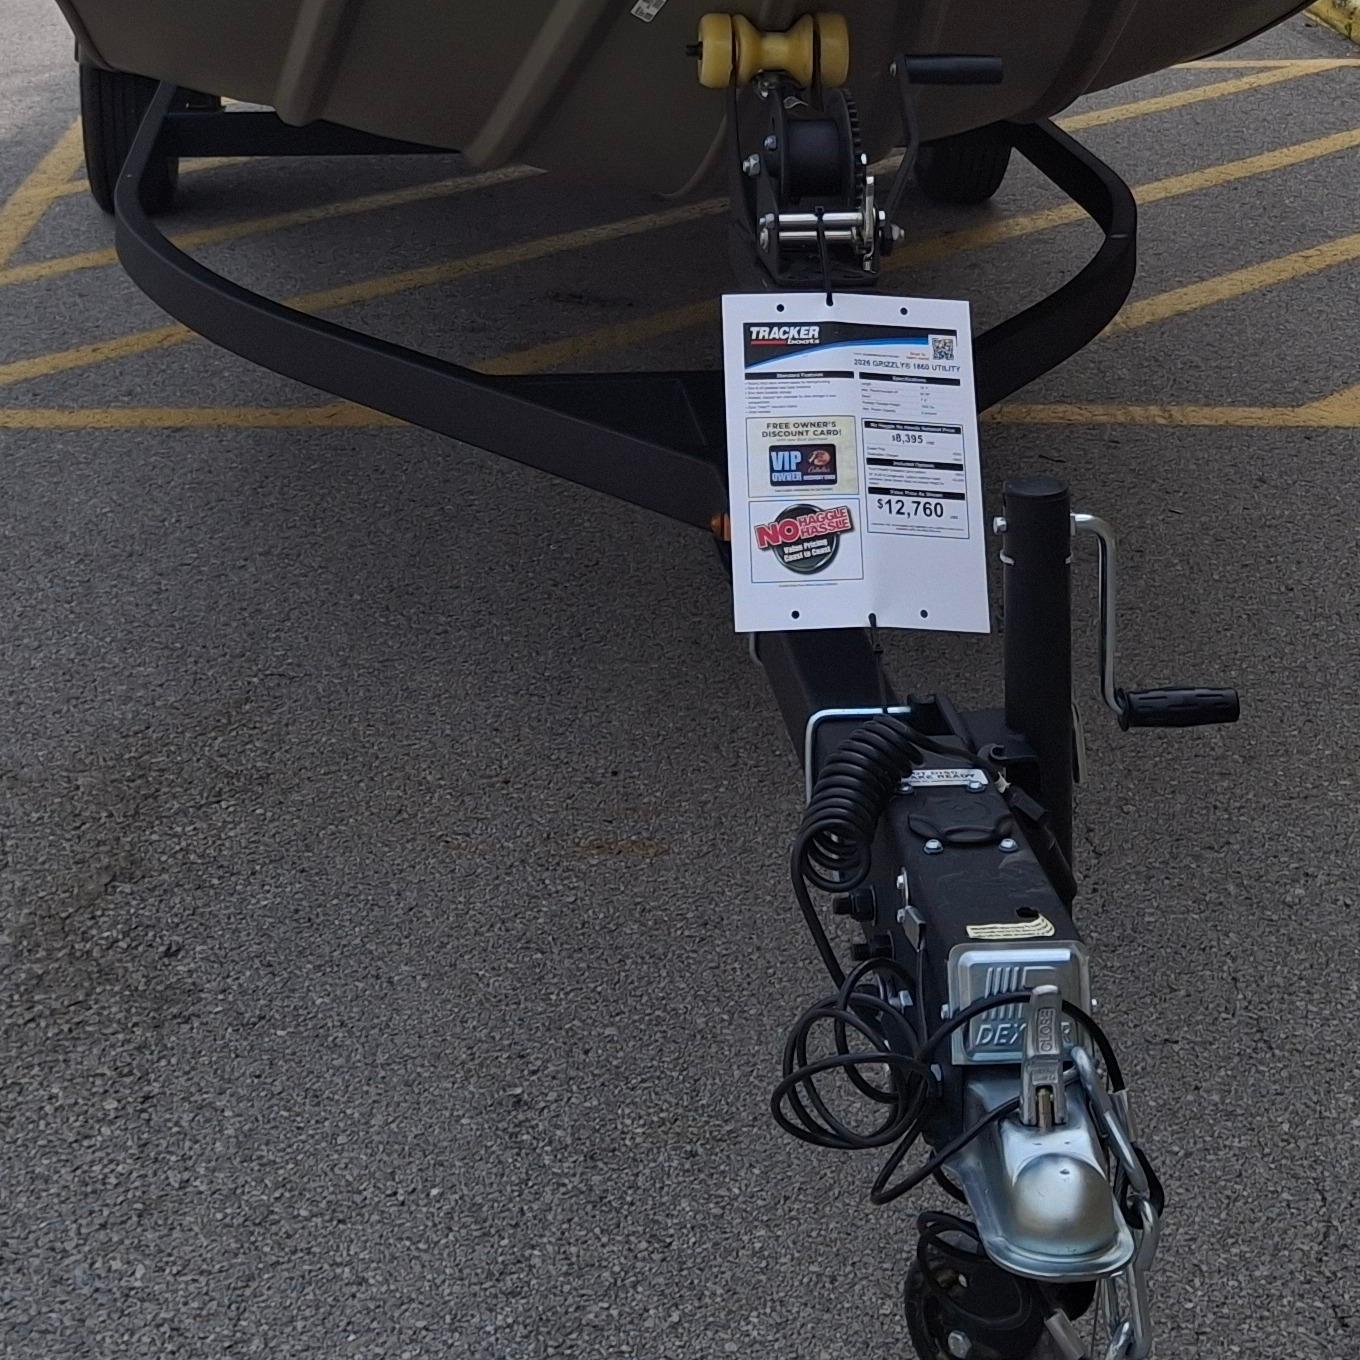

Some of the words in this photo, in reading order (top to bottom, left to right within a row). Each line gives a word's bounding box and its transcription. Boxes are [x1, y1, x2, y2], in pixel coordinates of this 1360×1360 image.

[750, 325, 820, 340] TRACKER
[931, 364, 961, 373] UTILITY
[761, 429, 810, 438] DISCOUNT
[812, 428, 842, 437] CARD!
[766, 422, 791, 430] FREE
[792, 421, 837, 430] OWNER'S
[891, 433, 924, 445] $8,395
[770, 450, 802, 471] VIP
[771, 471, 802, 482] OWNER
[876, 498, 944, 520] $12,760
[754, 518, 800, 548] NO
[797, 507, 848, 528] HAGGLE
[800, 519, 851, 539] HASSLE
[975, 1022, 1072, 1046] DEXR
